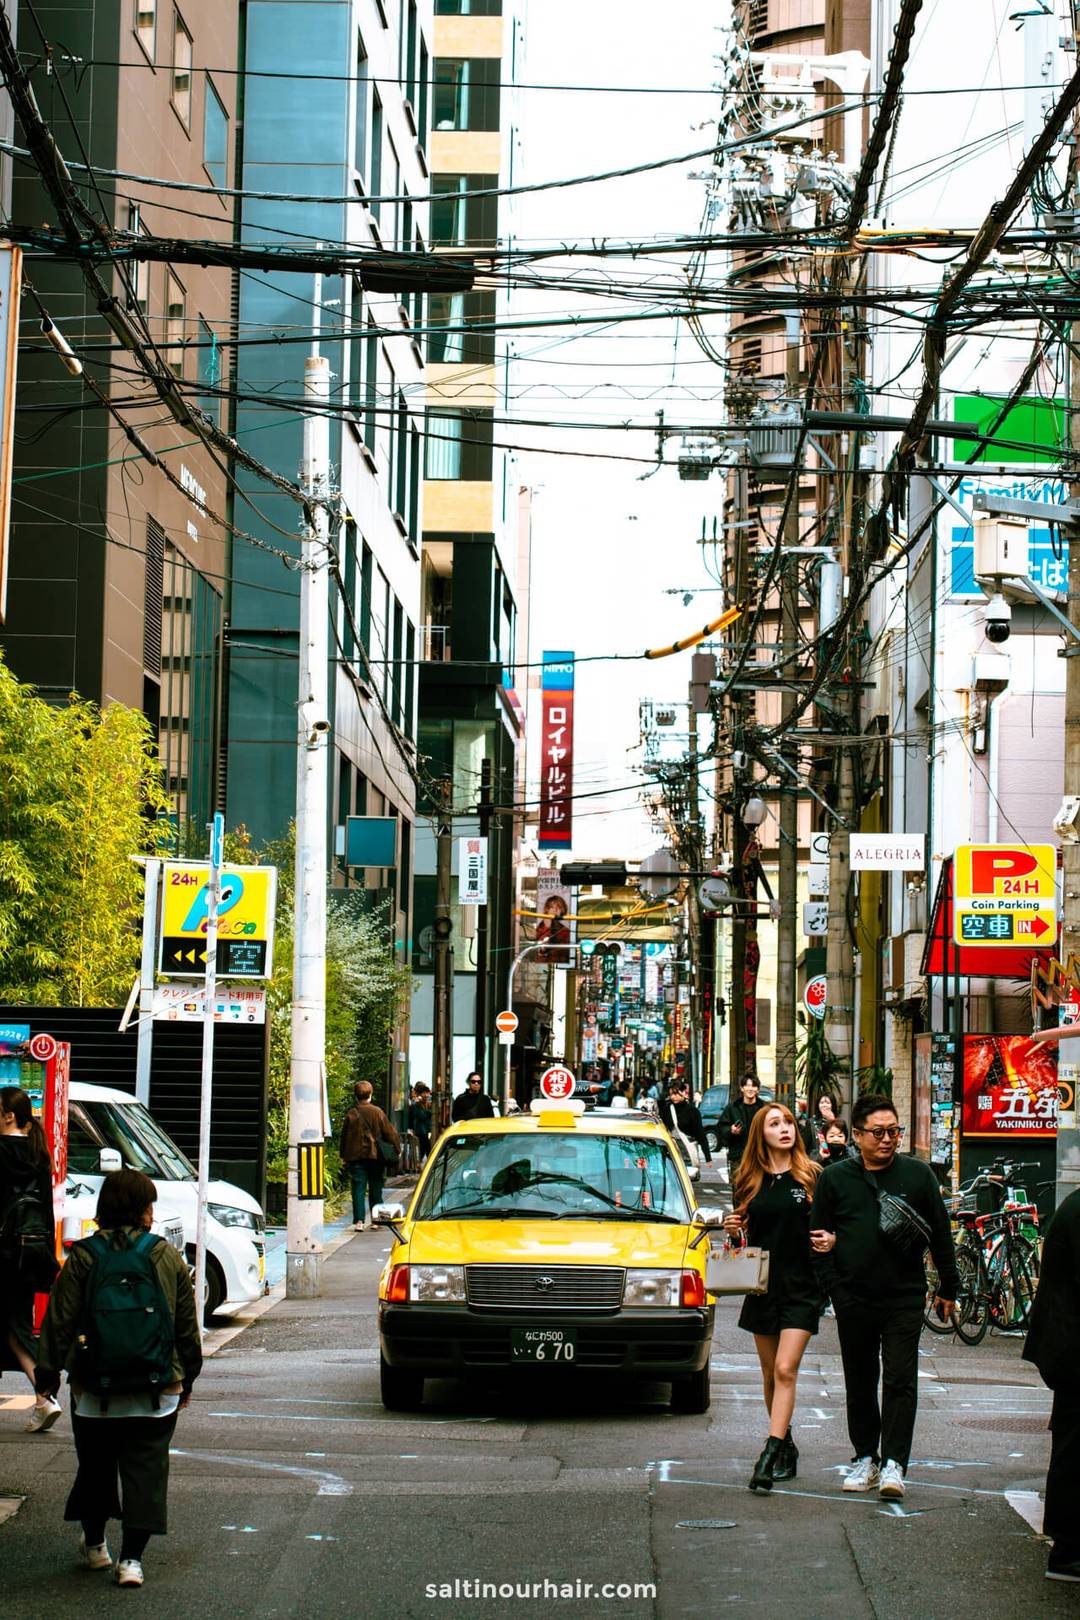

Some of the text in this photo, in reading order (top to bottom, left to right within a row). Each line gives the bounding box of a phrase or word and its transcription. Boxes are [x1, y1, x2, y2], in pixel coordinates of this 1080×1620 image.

[547, 707, 567, 824] ロイヤルビル
[854, 848, 921, 860] ALEGRIA
[171, 872, 198, 886] 24H
[468, 856, 479, 891] 三国屋
[971, 850, 1039, 894] P
[971, 900, 1040, 912] Coin Parking
[962, 914, 1010, 938] 空車
[1018, 921, 1032, 933] IN
[162, 988, 264, 1002] クレジットード利用可
[995, 1121, 1043, 1129] YAKINIKU
